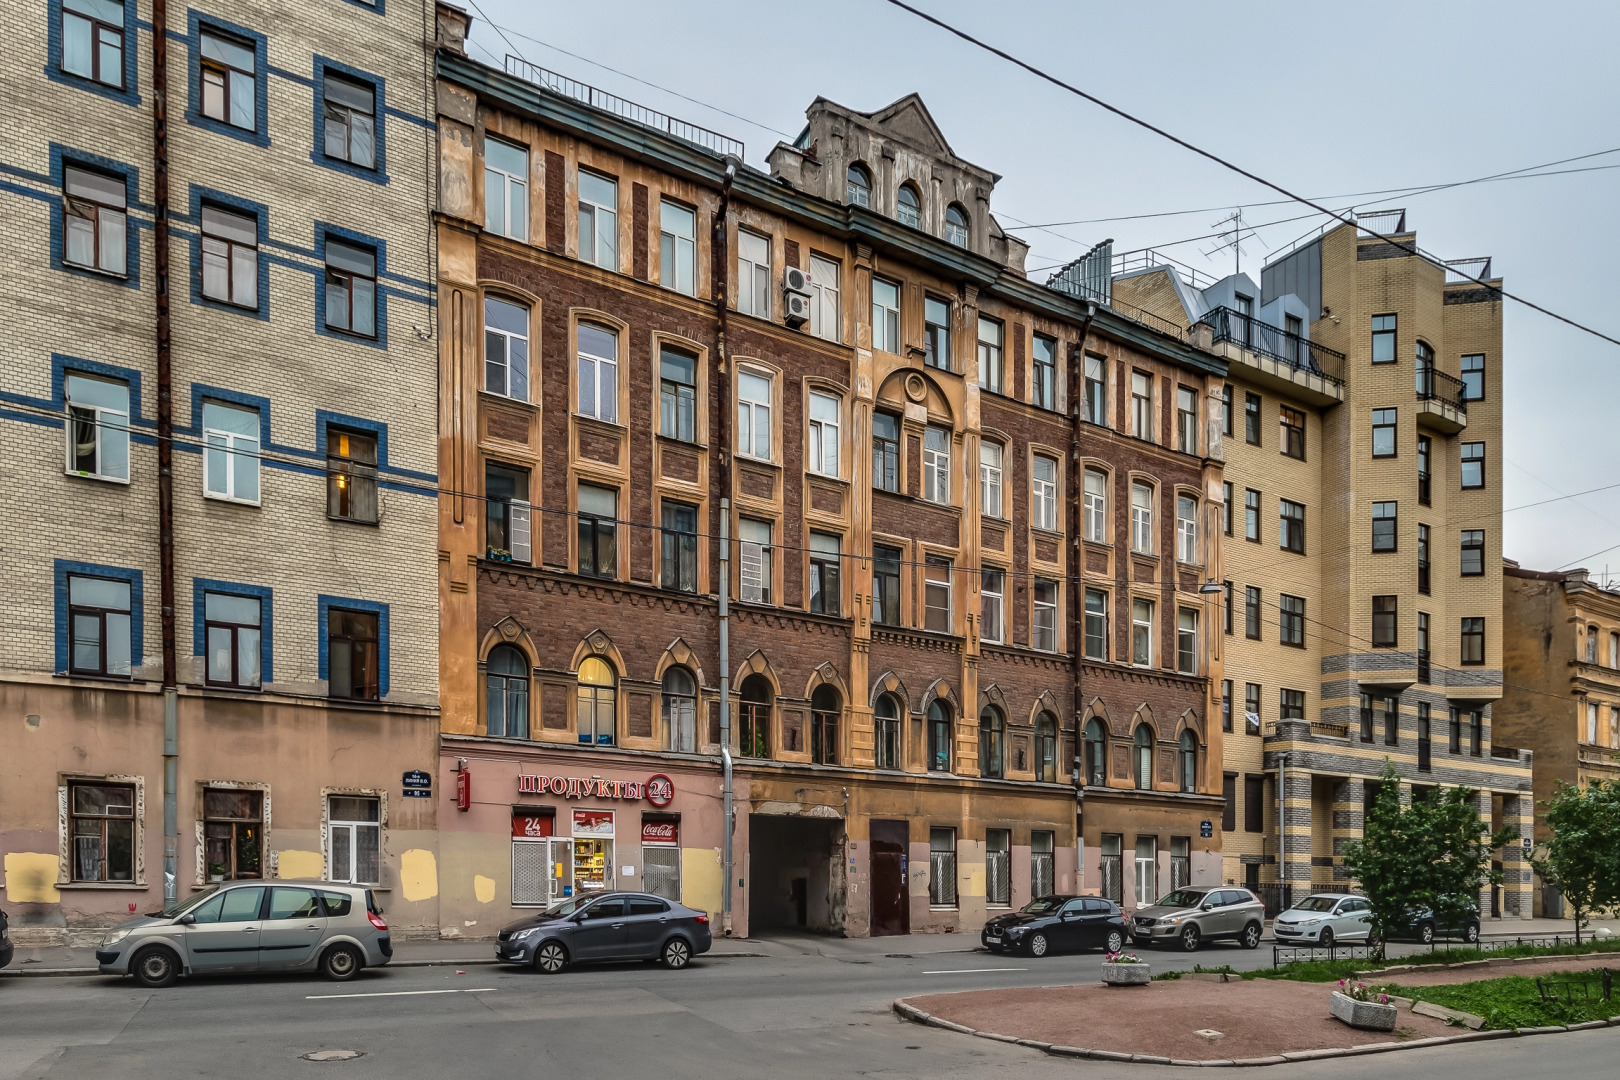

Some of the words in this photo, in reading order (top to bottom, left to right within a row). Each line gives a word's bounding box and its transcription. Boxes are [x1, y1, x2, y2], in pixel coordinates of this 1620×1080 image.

[518, 774, 643, 800] ПРОДУКТЫ
[649, 782, 672, 798] 24
[525, 818, 540, 830] 24
